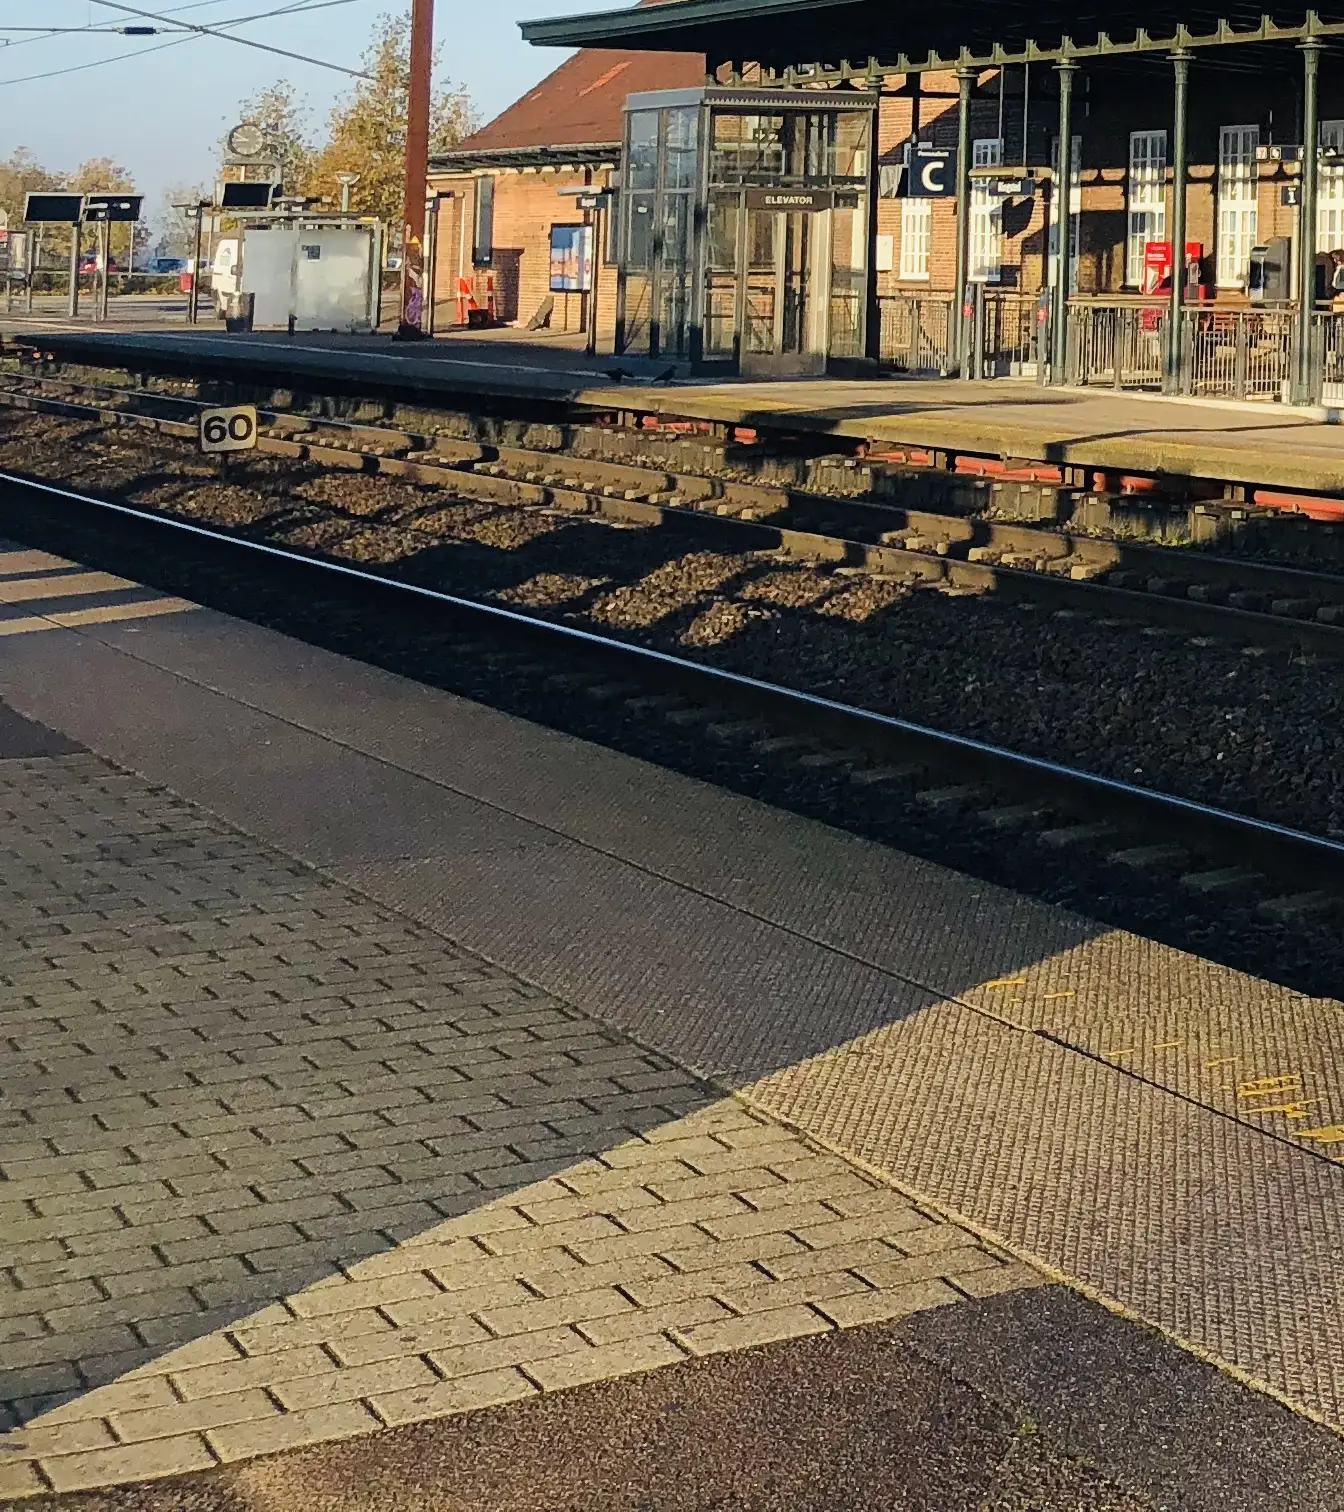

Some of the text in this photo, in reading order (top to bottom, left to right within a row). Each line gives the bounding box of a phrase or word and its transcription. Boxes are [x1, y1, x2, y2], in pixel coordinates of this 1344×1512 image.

[922, 161, 945, 192] C
[765, 195, 813, 205] ELEVATOR
[204, 414, 253, 443] 60
